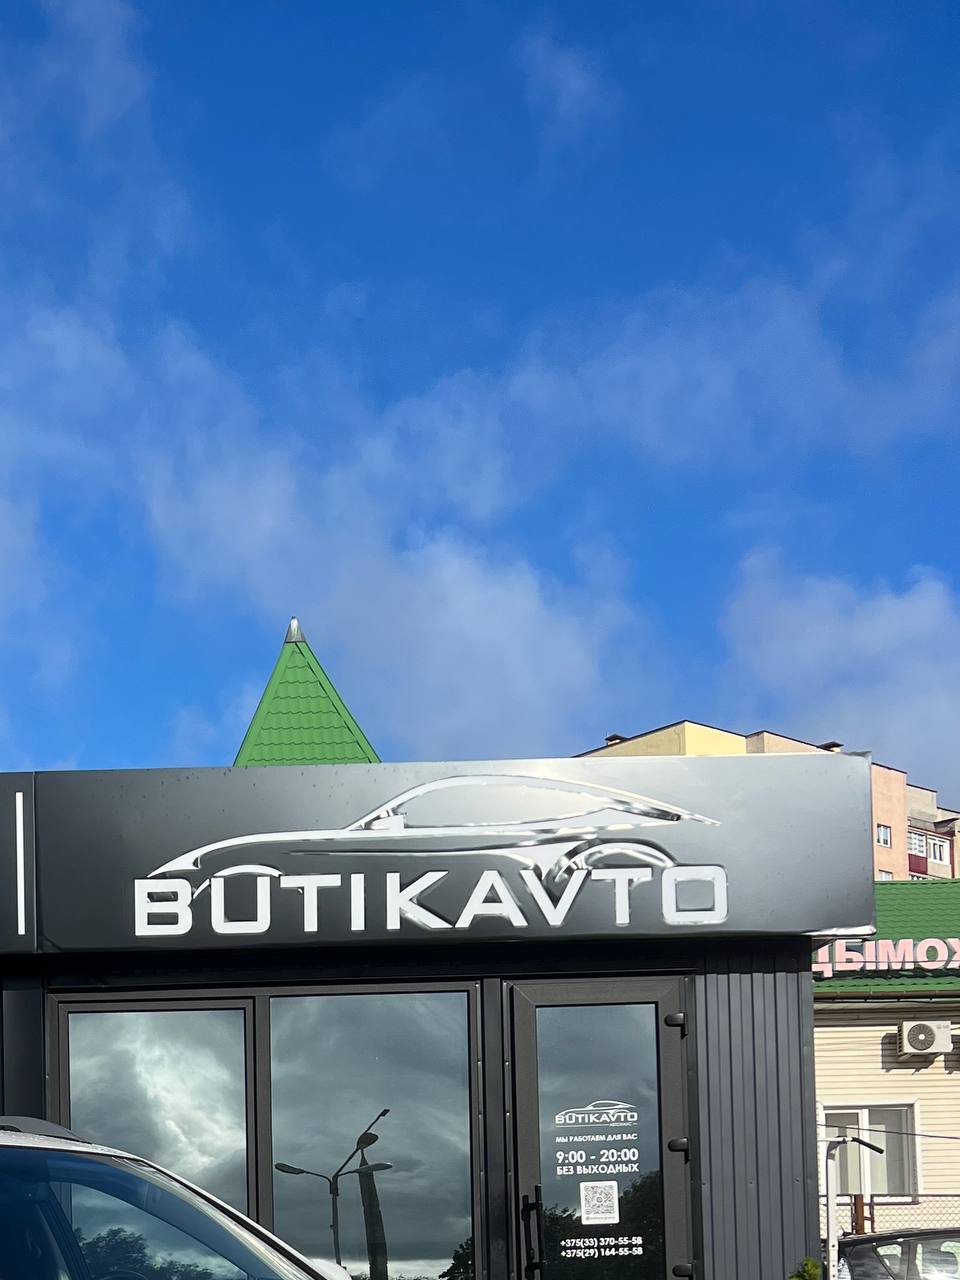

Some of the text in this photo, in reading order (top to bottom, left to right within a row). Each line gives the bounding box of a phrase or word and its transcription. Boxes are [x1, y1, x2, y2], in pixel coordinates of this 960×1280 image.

[134, 864, 730, 936] BUTIKAVTO
[555, 1112, 638, 1124] BUTIKAVTO
[556, 1150, 586, 1163] 9:00
[599, 1148, 639, 1162] 20:00
[556, 1163, 639, 1175] БЕЗ ВЫХОДНЫХ
[560, 1236, 643, 1248] +375(33) 370-55-58
[560, 1247, 643, 1259] +375(29) 164-55-58
